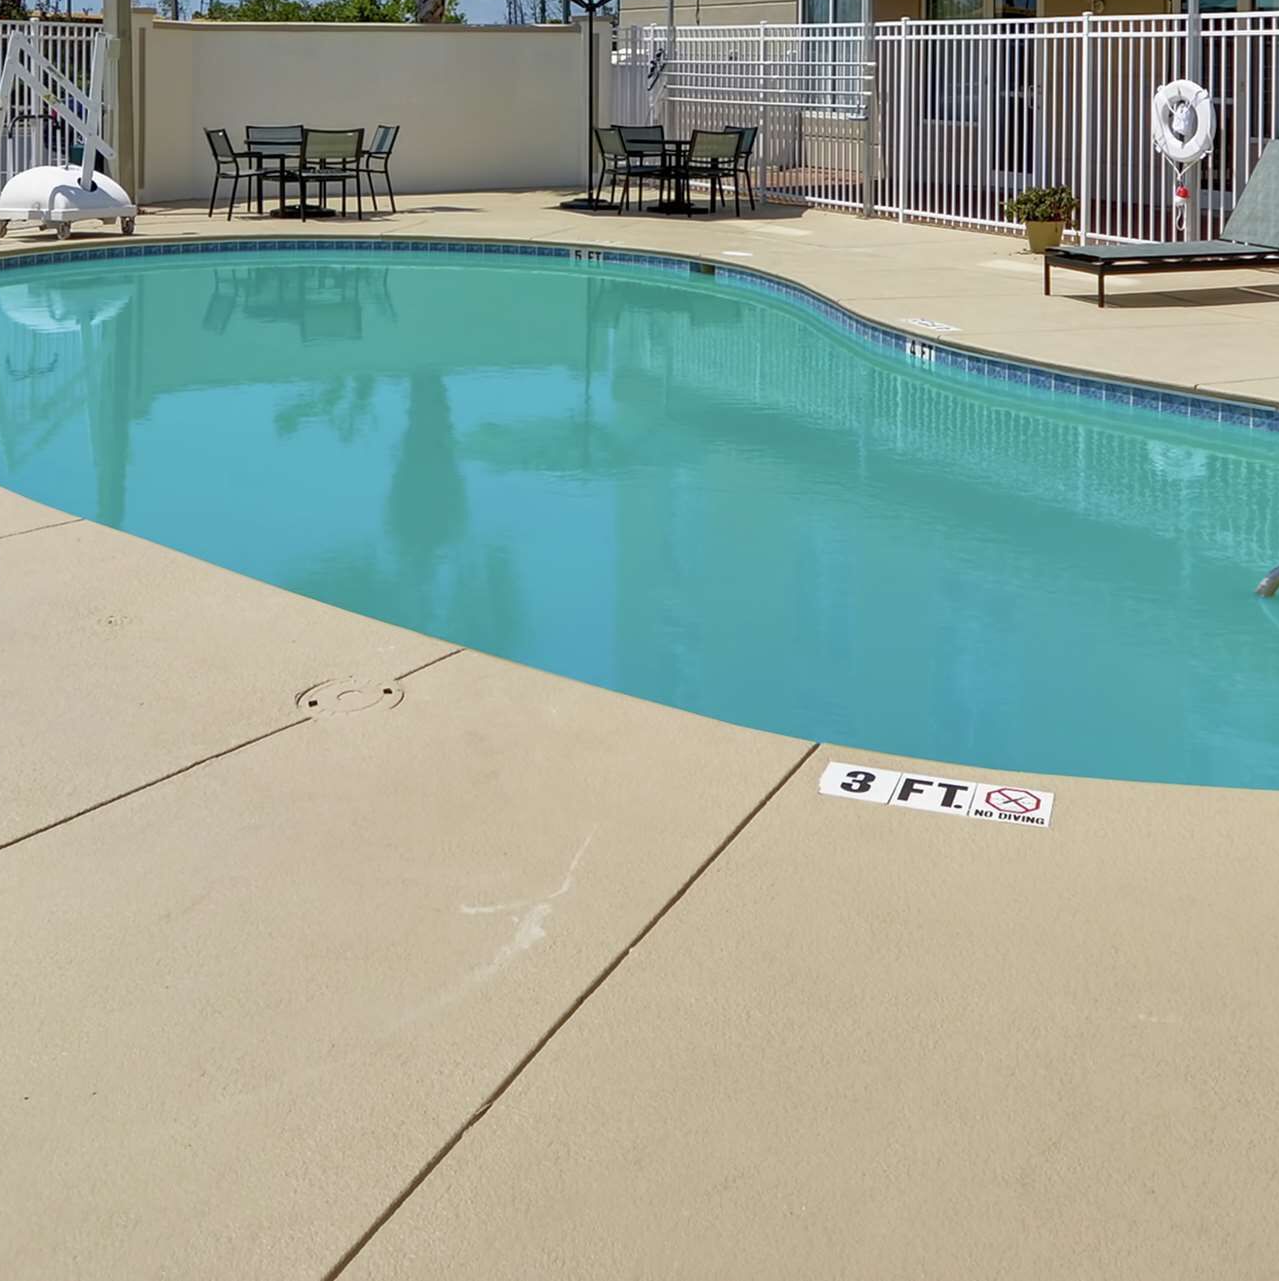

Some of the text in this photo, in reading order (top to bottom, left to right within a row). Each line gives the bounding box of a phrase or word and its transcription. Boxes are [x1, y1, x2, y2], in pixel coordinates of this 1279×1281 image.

[587, 250, 601, 261] FT
[910, 339, 934, 360] 4 FT
[840, 770, 876, 794] 3
[973, 808, 1045, 826] NO DIVING
